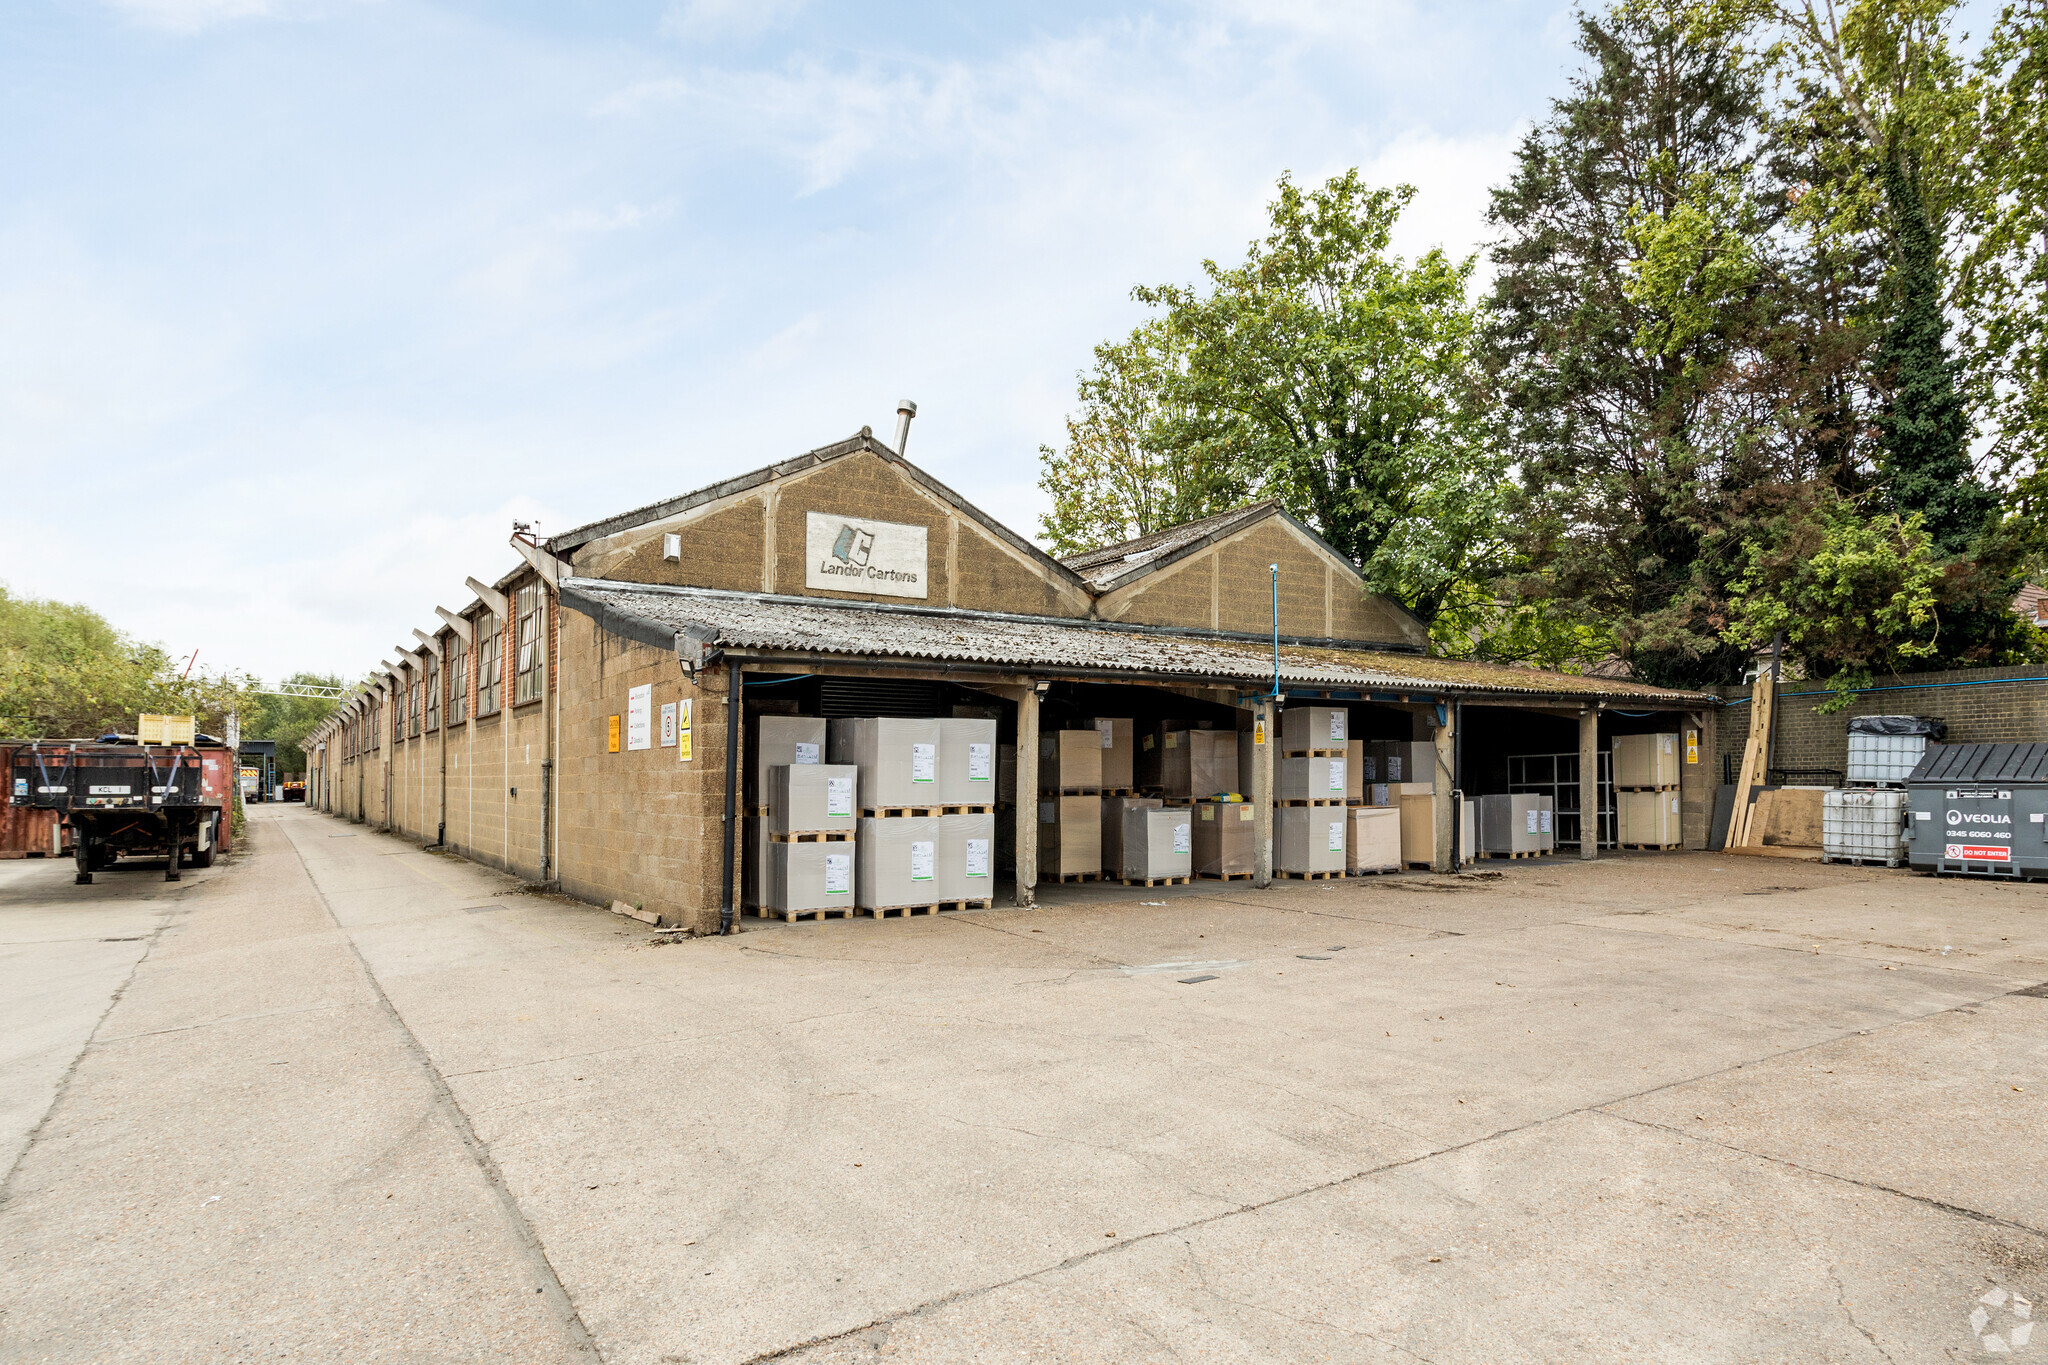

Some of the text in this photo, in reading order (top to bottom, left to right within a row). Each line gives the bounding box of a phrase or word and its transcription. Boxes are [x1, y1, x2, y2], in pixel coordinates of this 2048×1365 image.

[820, 560, 918, 583] Landor Cartons
[1963, 814, 2012, 824] VEOLIA
